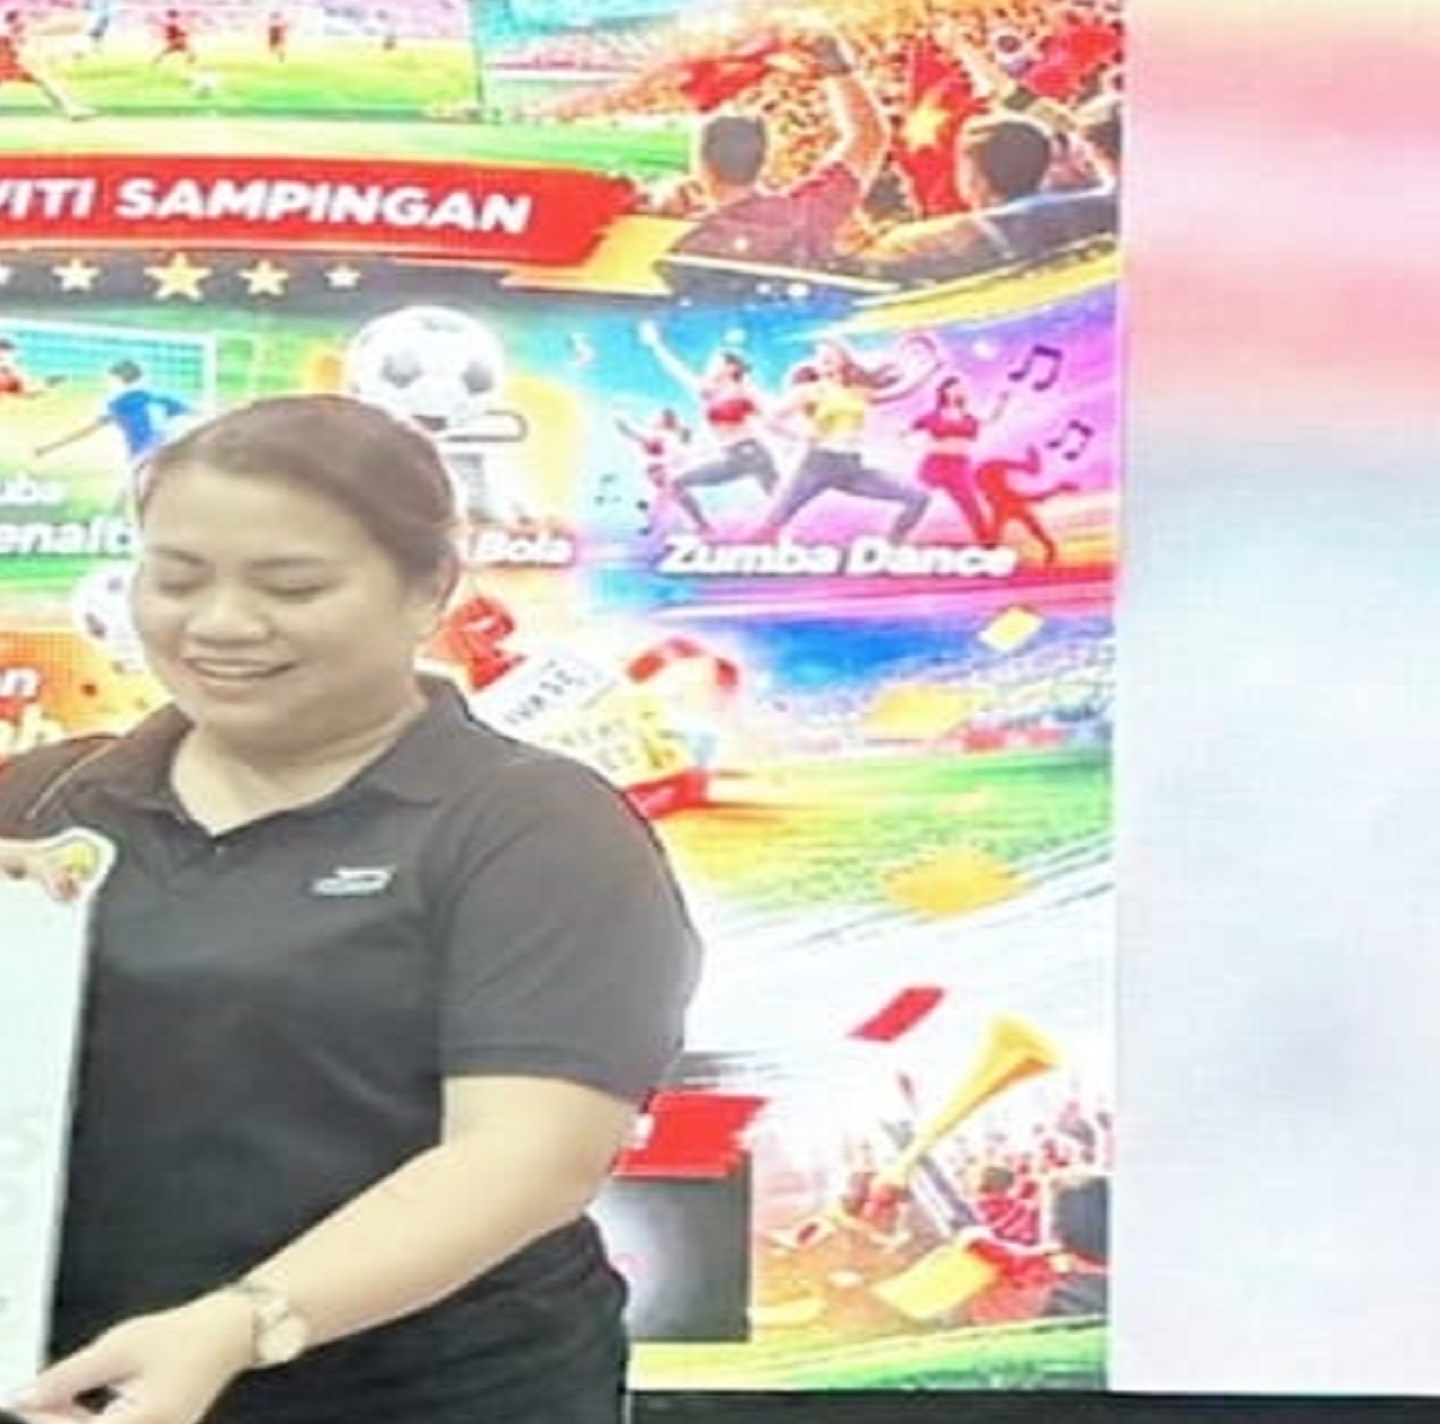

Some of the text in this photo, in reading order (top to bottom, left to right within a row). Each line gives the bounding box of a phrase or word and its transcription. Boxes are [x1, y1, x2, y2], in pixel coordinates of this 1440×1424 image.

[116, 179, 531, 233] SAMPINGAN
[661, 534, 1016, 576] Zumba Dance
